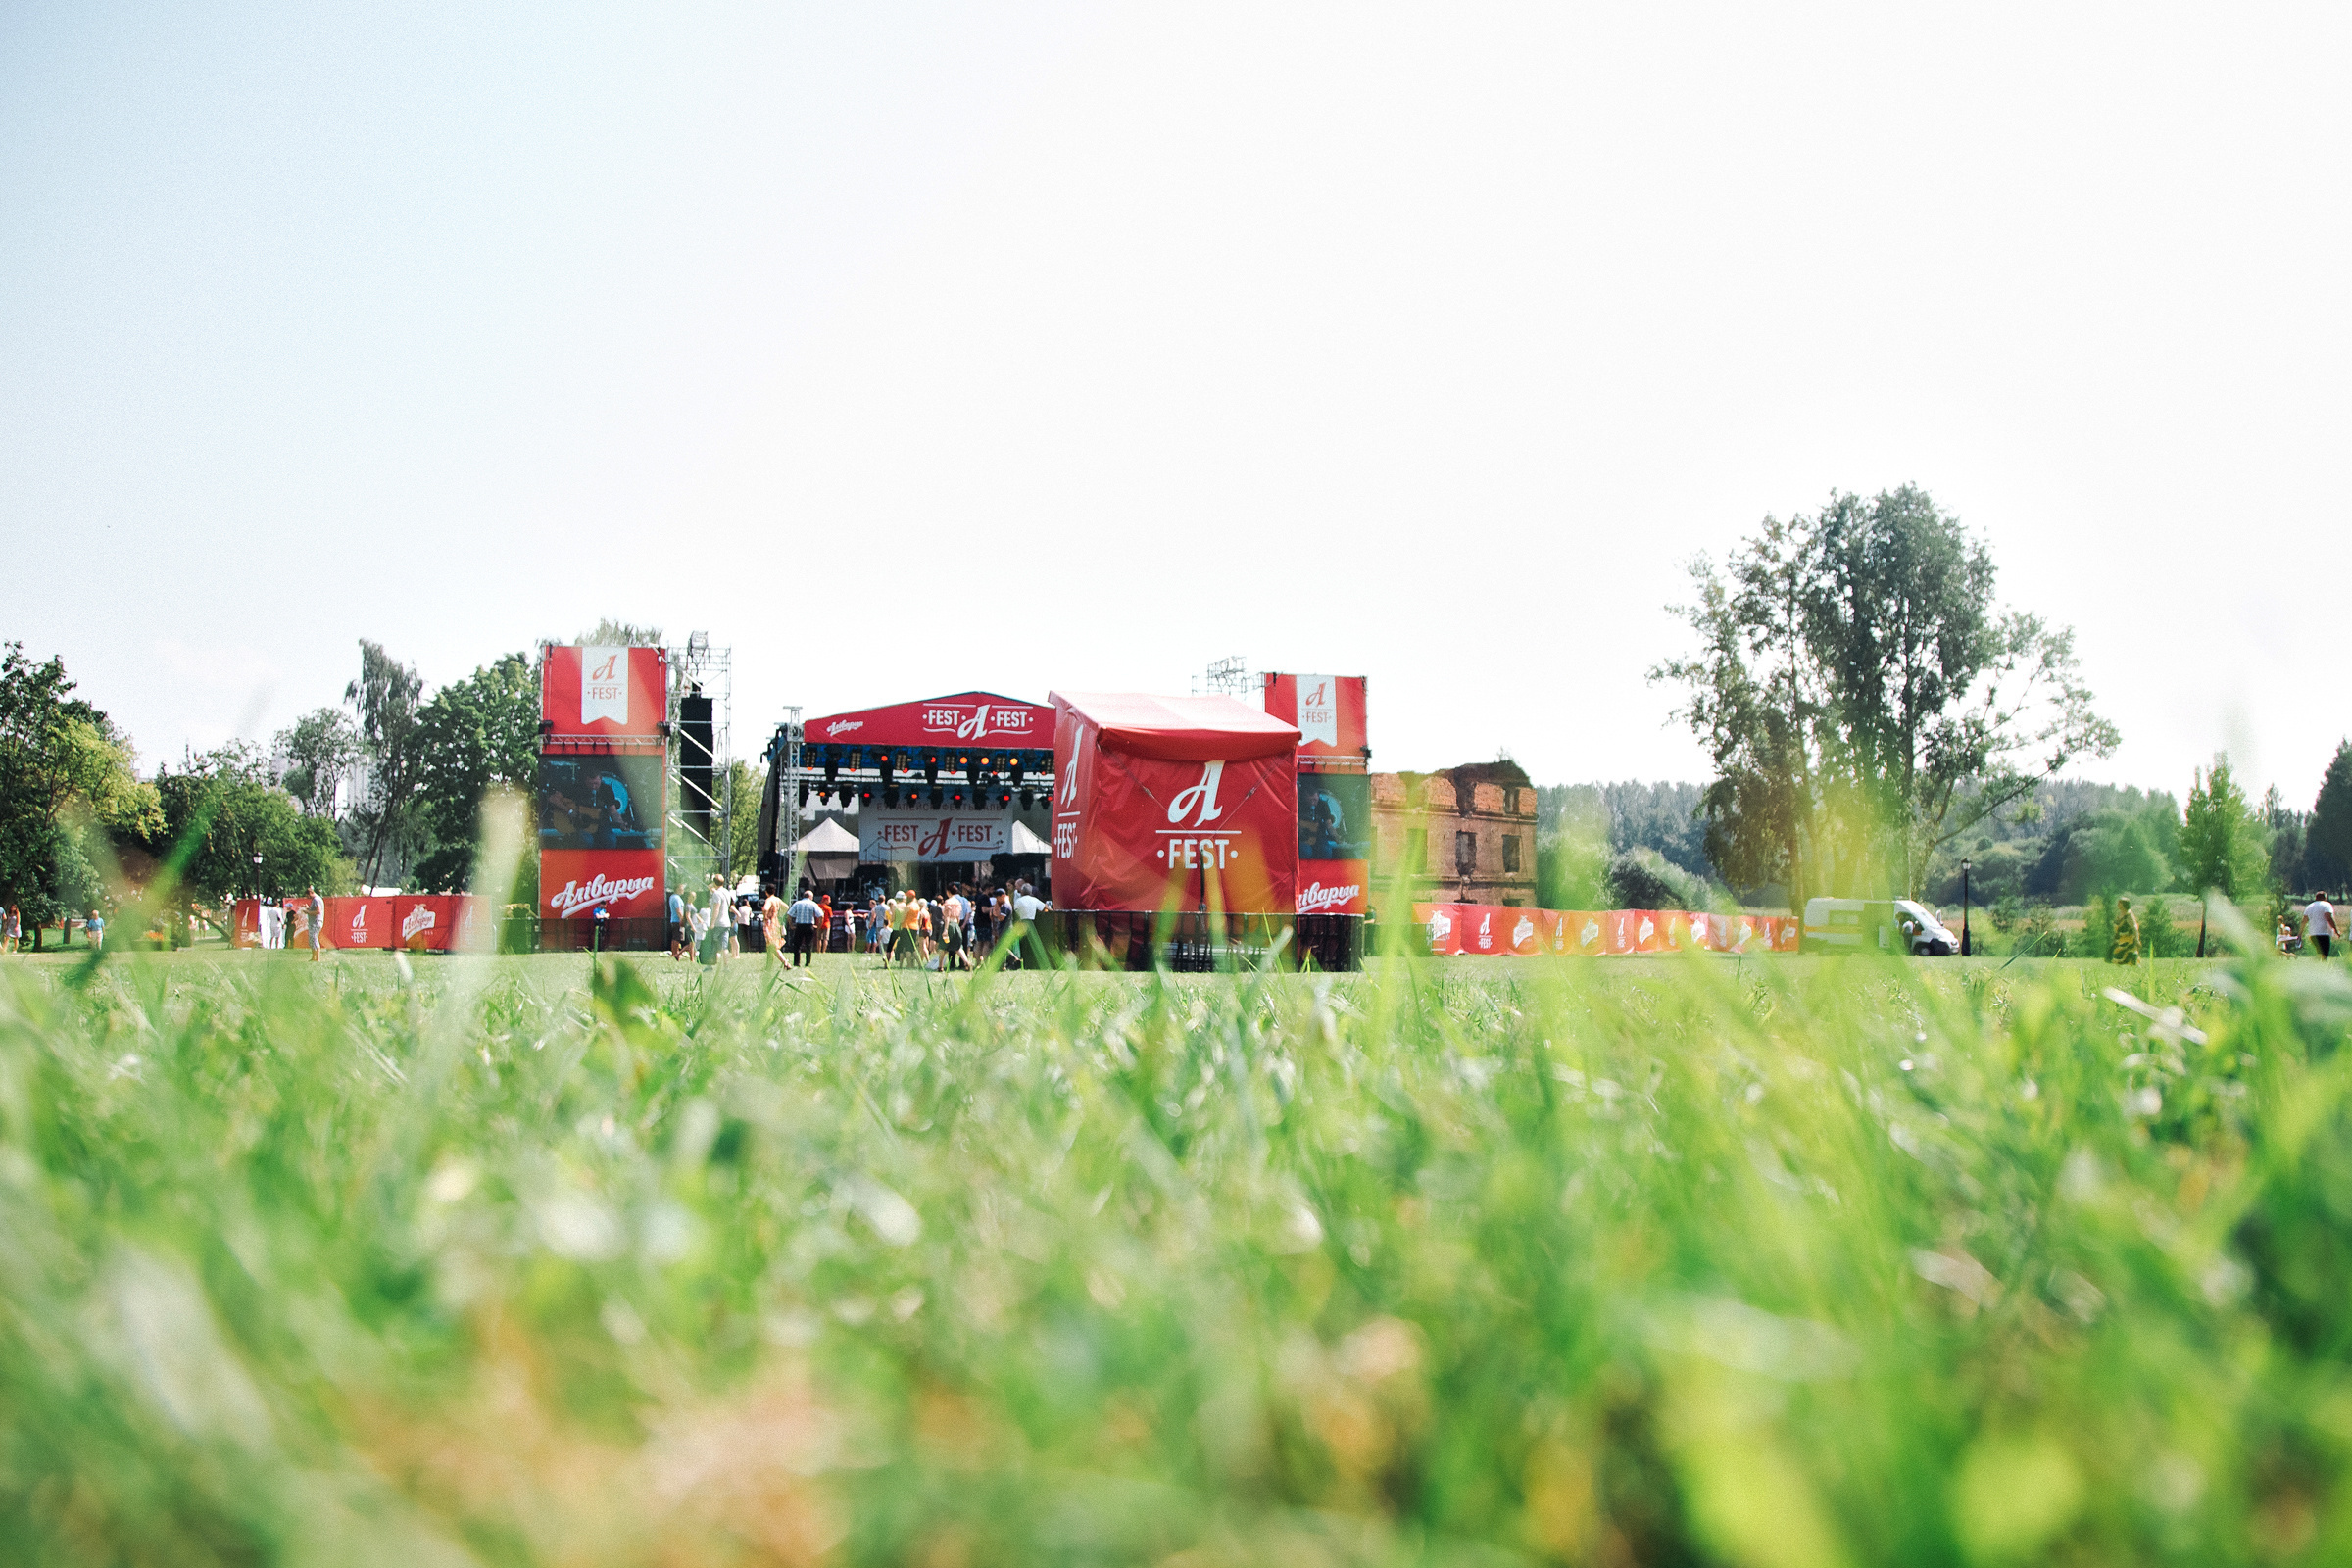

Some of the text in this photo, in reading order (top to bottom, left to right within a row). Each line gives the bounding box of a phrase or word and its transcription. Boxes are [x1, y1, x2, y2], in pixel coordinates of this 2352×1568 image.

[592, 654, 618, 682] A
[592, 687, 618, 700] FEST
[1305, 682, 1327, 708] A
[928, 704, 1028, 741] FEST A FEST
[1306, 711, 1329, 723] FEST
[1167, 760, 1226, 828] A
[884, 816, 993, 858] FEST A FEST
[1057, 822, 1077, 858] FEST
[1168, 839, 1230, 869] FEST
[353, 931, 368, 944] FEST
